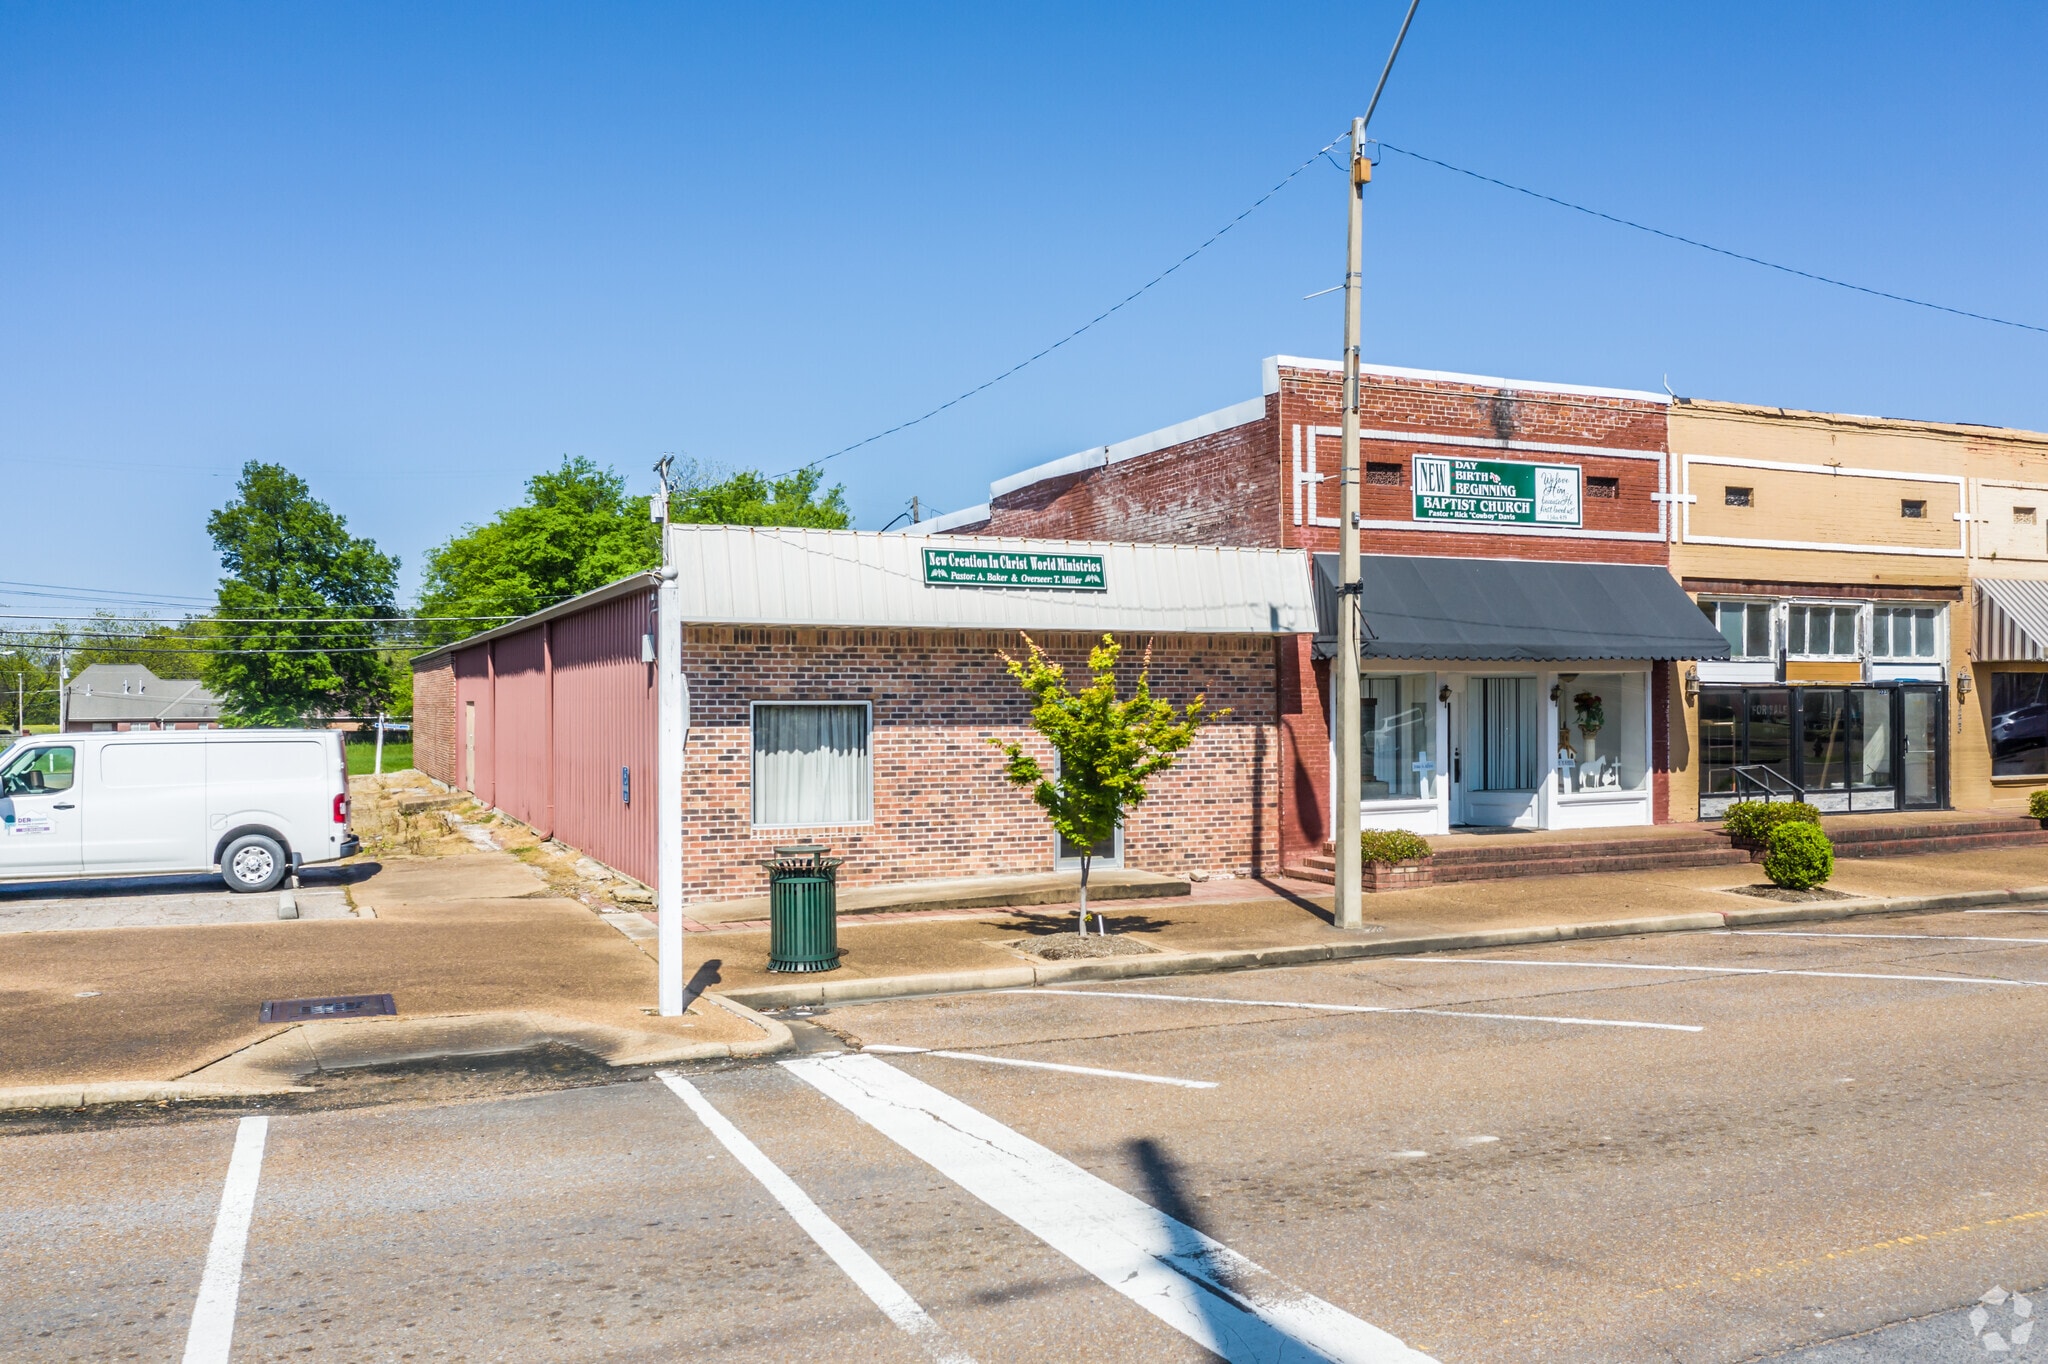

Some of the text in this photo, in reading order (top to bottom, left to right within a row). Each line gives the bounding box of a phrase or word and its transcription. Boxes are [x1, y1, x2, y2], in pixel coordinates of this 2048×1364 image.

[1455, 462, 1478, 470] DAY
[1420, 462, 1446, 492] NEW
[1455, 471, 1489, 481] BIRTH
[1455, 483, 1516, 497] BEGINNING
[1423, 497, 1530, 513] BAPTIST CHURCH
[1428, 510, 1450, 518] Pastor
[1454, 511, 1468, 519] Rick
[928, 552, 1101, 572] New Creation In Christ World Ministries
[950, 572, 976, 581] Pastor:
[977, 573, 985, 581] A.
[987, 573, 1008, 582] Baker
[1021, 575, 1053, 583] Overseer:
[1062, 576, 1082, 584] Miller
[1752, 705, 1767, 715] FOR
